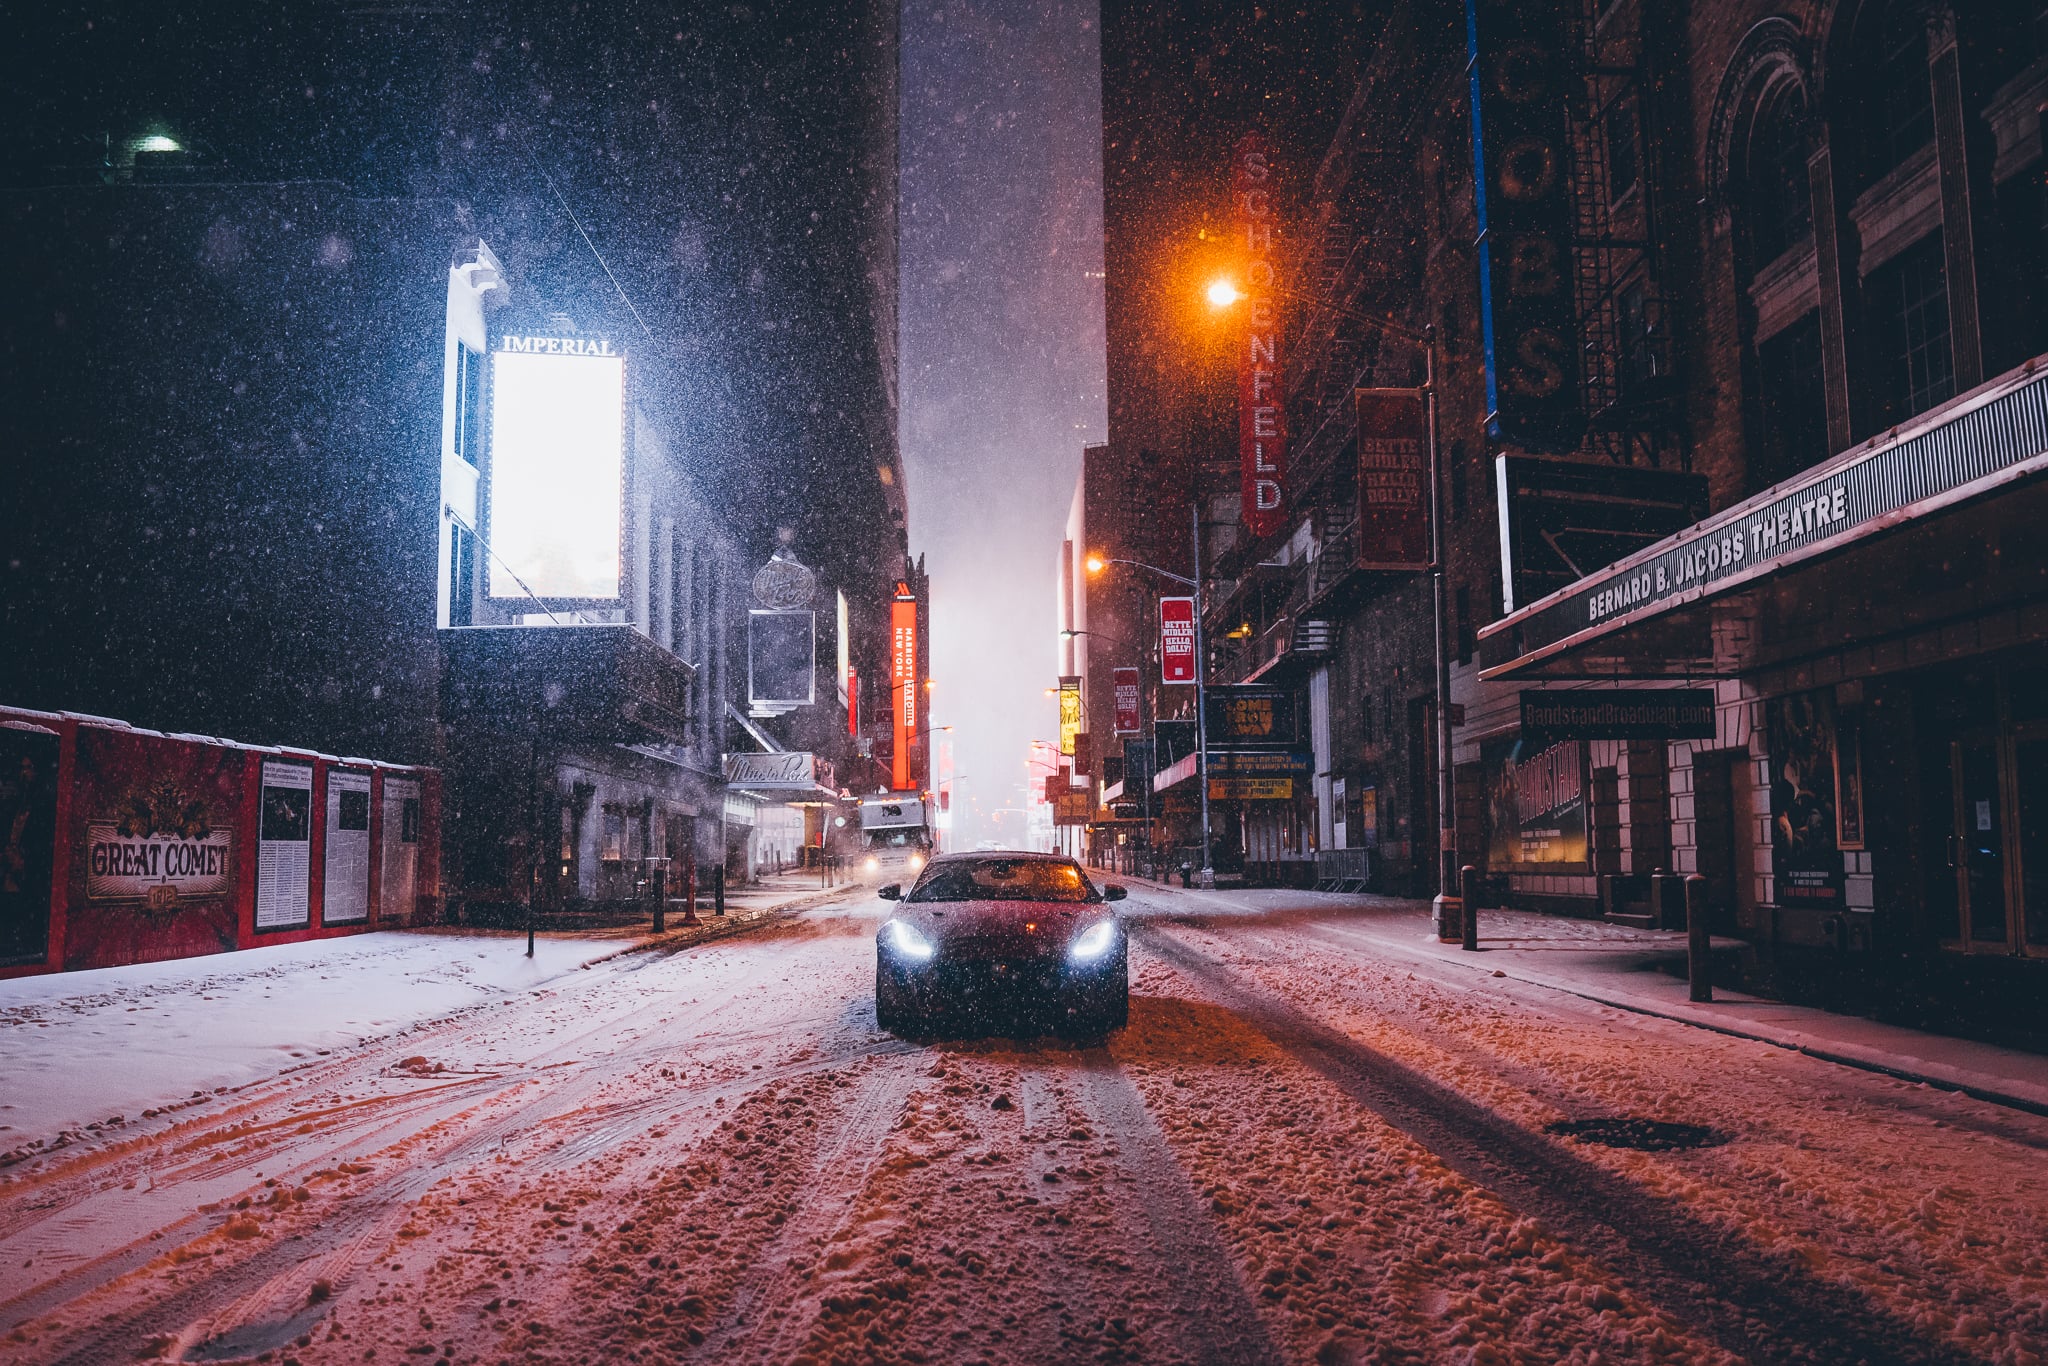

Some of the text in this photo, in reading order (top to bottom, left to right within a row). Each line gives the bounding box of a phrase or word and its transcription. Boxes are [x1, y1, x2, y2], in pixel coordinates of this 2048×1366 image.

[502, 335, 616, 357] IMPERIAL
[1243, 152, 1281, 510] SCHOENFELD
[1364, 438, 1418, 453] BETTE
[1360, 453, 1422, 470] MIDLER
[1588, 485, 1848, 621] BERNARD B. JACOBS THEATRE
[1162, 628, 1194, 637] MIDLER
[1164, 620, 1192, 629] BETTE
[895, 627, 904, 677] NEW YORK
[904, 627, 914, 678] MARRIOTT
[1525, 703, 1713, 729] BandstandBroadway.com
[1517, 740, 1581, 825] BANDSTAND
[91, 842, 228, 876] GREAT COMET
